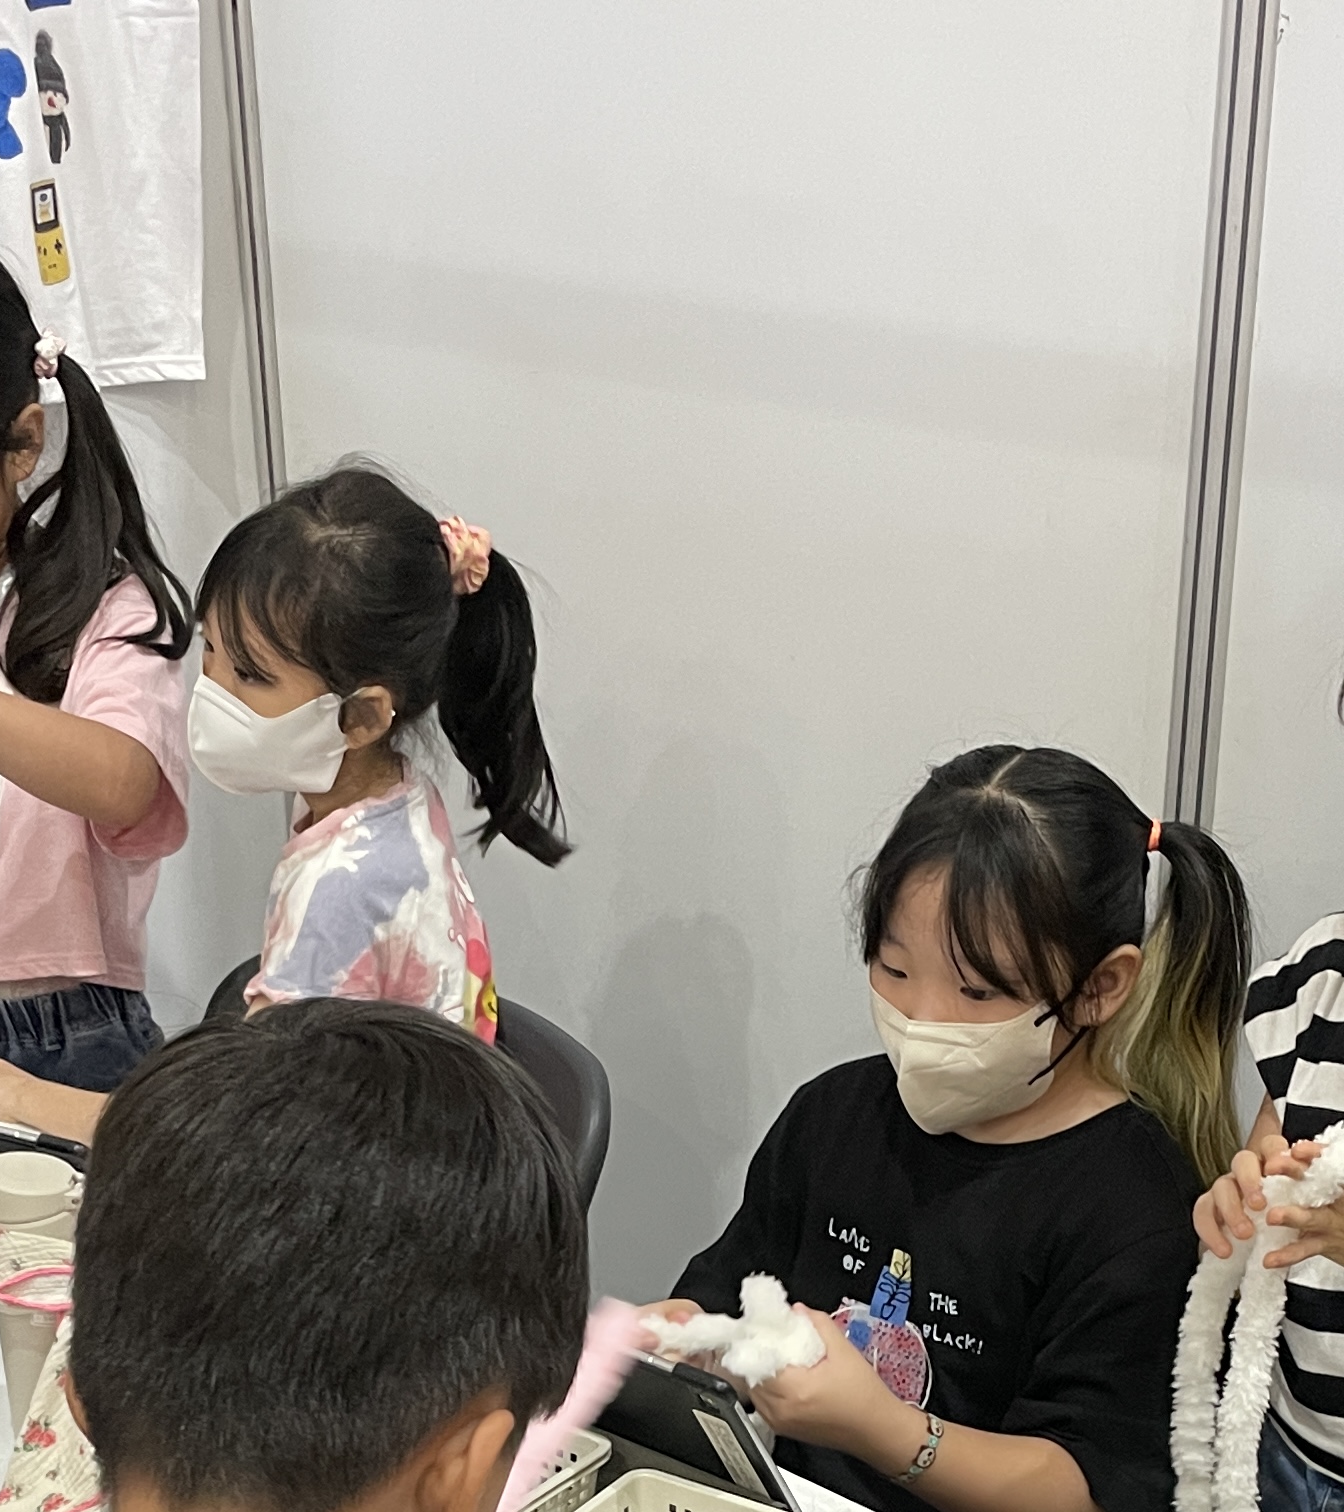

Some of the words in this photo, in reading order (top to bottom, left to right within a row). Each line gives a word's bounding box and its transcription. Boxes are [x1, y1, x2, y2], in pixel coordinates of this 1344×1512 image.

[842, 1254, 865, 1274] OF
[929, 1292, 958, 1315] THE
[922, 1324, 983, 1354] BLACK!
